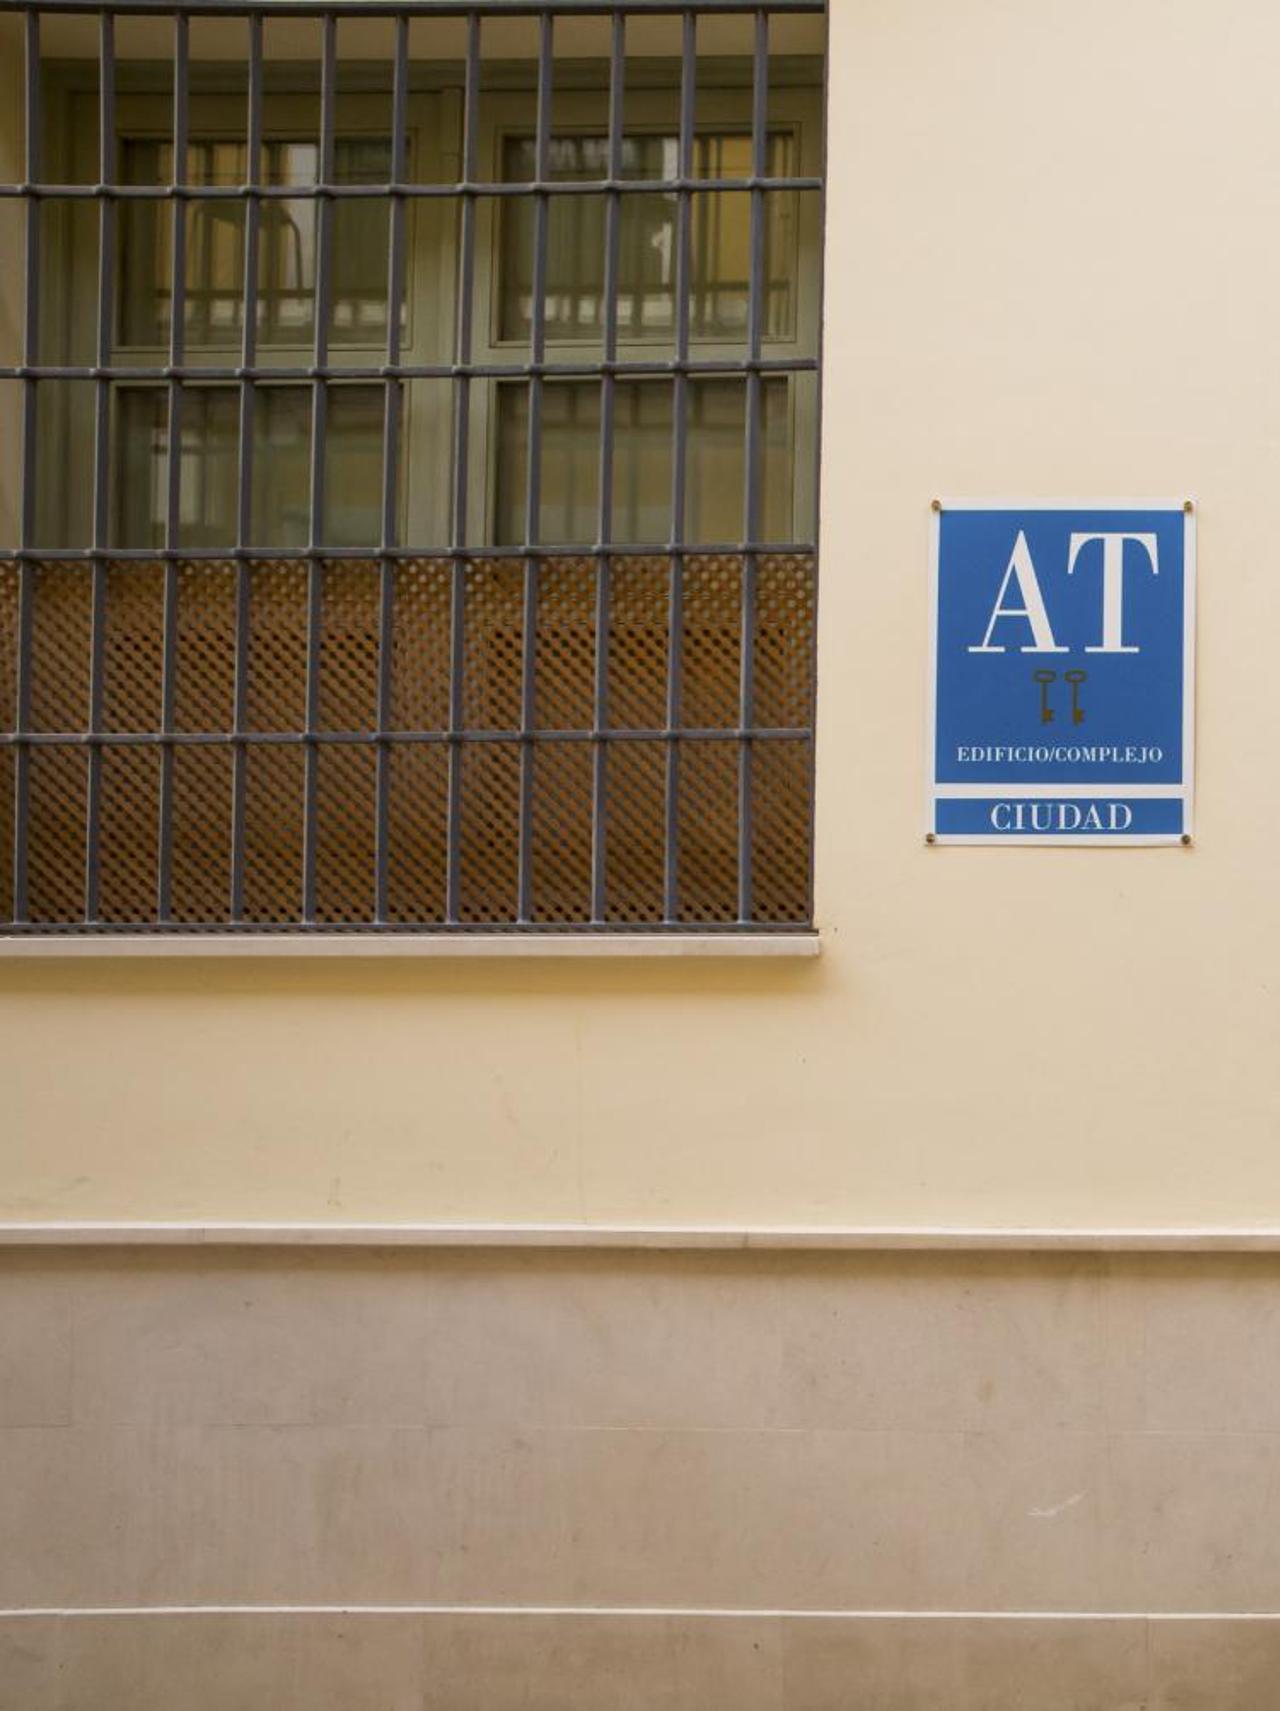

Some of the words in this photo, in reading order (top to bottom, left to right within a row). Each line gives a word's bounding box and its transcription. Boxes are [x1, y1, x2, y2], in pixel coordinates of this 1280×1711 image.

[968, 529, 1159, 653] AT
[957, 745, 1163, 764] EDIFICIO/COMPLEJO
[990, 802, 1133, 831] CIUDAD
